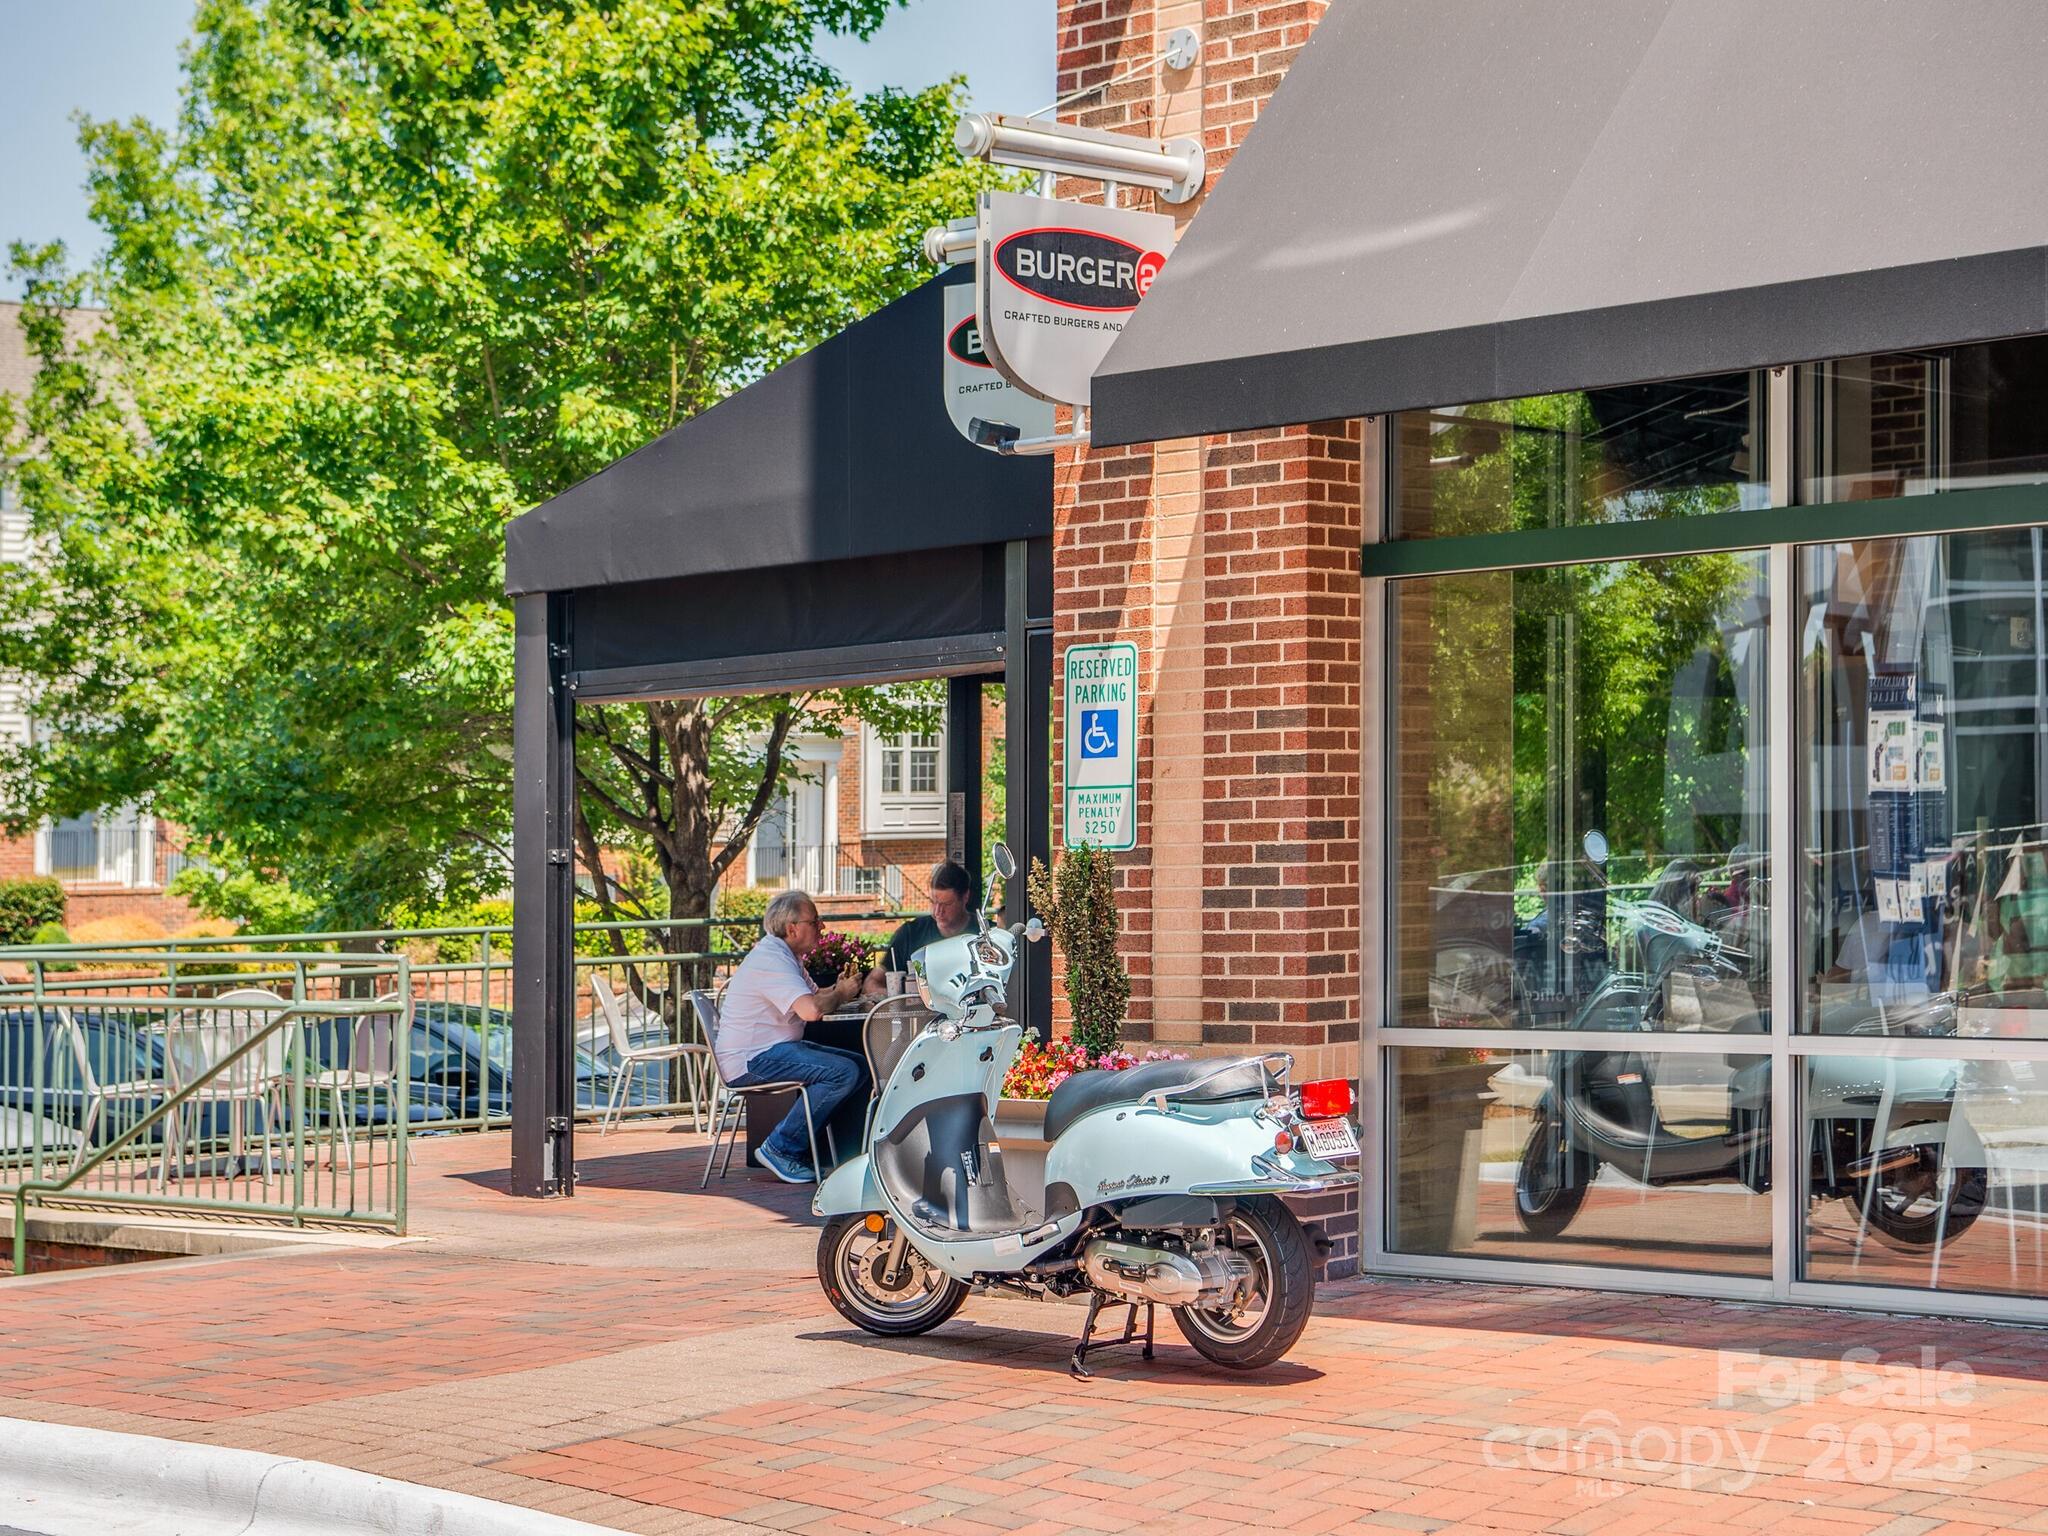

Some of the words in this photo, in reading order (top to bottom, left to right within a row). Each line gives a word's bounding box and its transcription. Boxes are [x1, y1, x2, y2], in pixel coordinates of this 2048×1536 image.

[1016, 248, 1134, 290] BURGER
[1004, 310, 1051, 325] CRAFTED
[1053, 316, 1100, 330] BURGERS
[1102, 322, 1123, 332] AND
[958, 381, 1003, 395] CRAFTED
[1070, 657, 1131, 679] RESERVED
[1075, 682, 1126, 704] PARKING
[1078, 793, 1122, 805] MAXIMUM
[1078, 807, 1121, 819] PENALTY
[1085, 820, 1116, 835] $250
